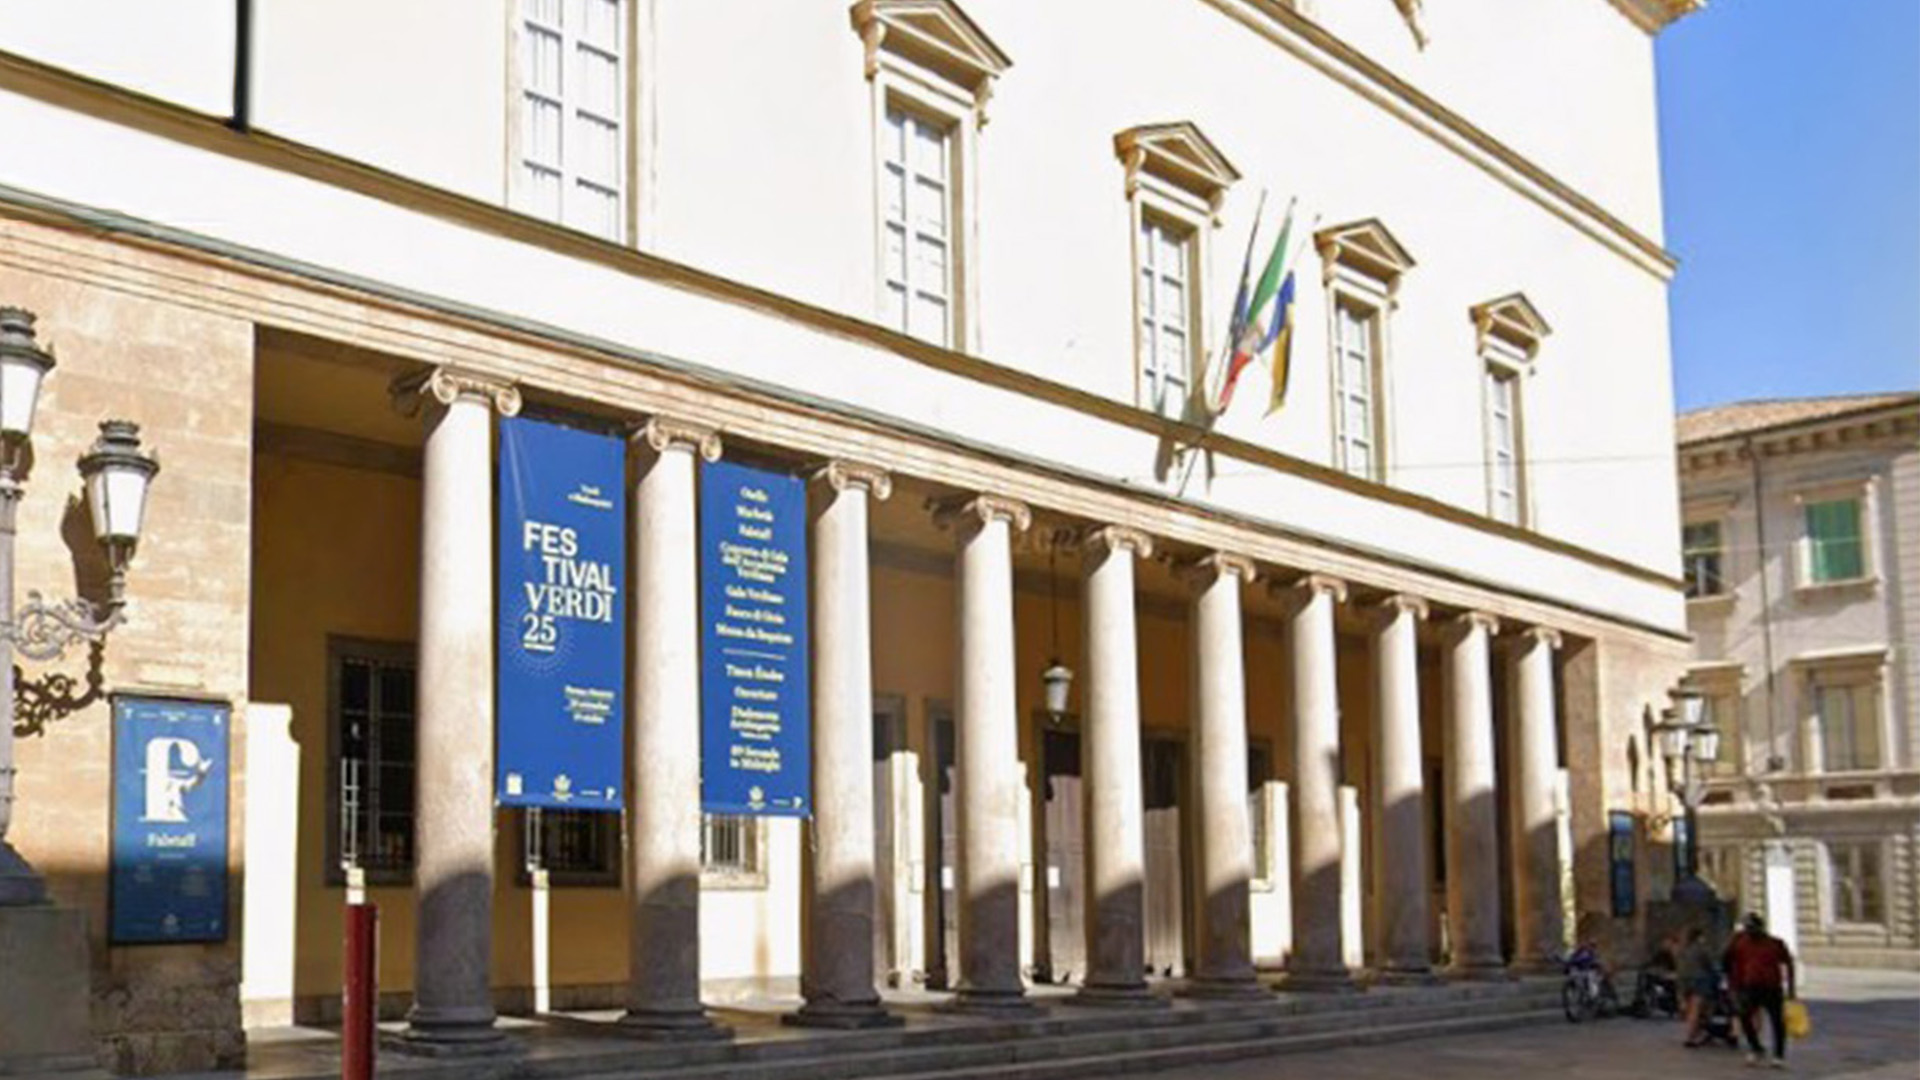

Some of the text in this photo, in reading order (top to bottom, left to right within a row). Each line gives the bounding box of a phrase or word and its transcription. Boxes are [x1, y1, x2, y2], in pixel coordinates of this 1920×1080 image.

[523, 520, 578, 557] FES
[541, 556, 617, 595] TIVAL
[523, 581, 612, 622] VERDI
[523, 612, 557, 644] 25
